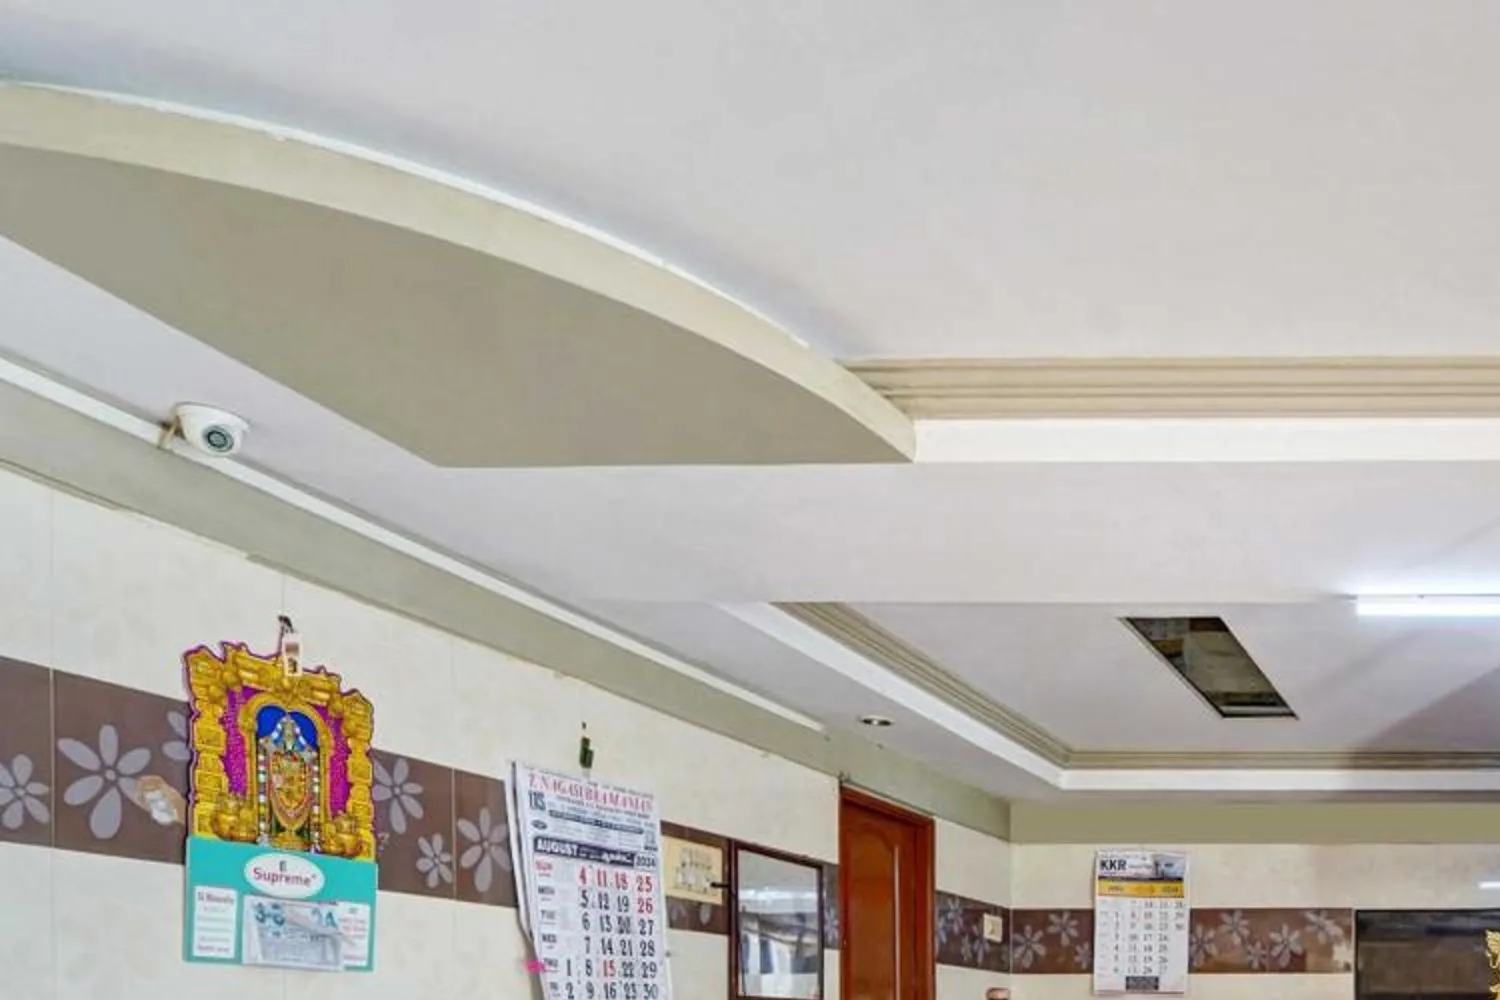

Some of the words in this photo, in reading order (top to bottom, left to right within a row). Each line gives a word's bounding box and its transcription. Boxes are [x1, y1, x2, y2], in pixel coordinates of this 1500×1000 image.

[537, 838, 578, 857] AUGUST
[1100, 859, 1127, 871] KKR
[252, 867, 312, 887] Supreme
[579, 866, 587, 885] 4
[597, 870, 608, 888] 11
[636, 875, 653, 893] 25
[580, 889, 590, 909] 5
[597, 892, 610, 911] 12
[617, 895, 630, 913] 19
[637, 898, 653, 914] 26
[582, 912, 591, 931] 6
[600, 915, 613, 933] 13
[638, 920, 654, 936] 27
[584, 936, 591, 955] 7
[601, 938, 614, 956] 14
[620, 940, 633, 957] 21
[639, 940, 655, 958] 28
[566, 959, 572, 977] 1
[585, 959, 593, 977] 8
[603, 959, 616, 977] 15
[621, 961, 635, 978] 22
[641, 962, 658, 978] 29
[565, 982, 575, 1000] 2
[586, 981, 595, 999] 9
[603, 982, 617, 1000] 16
[623, 983, 638, 1000] 23
[643, 983, 660, 1000] 30
